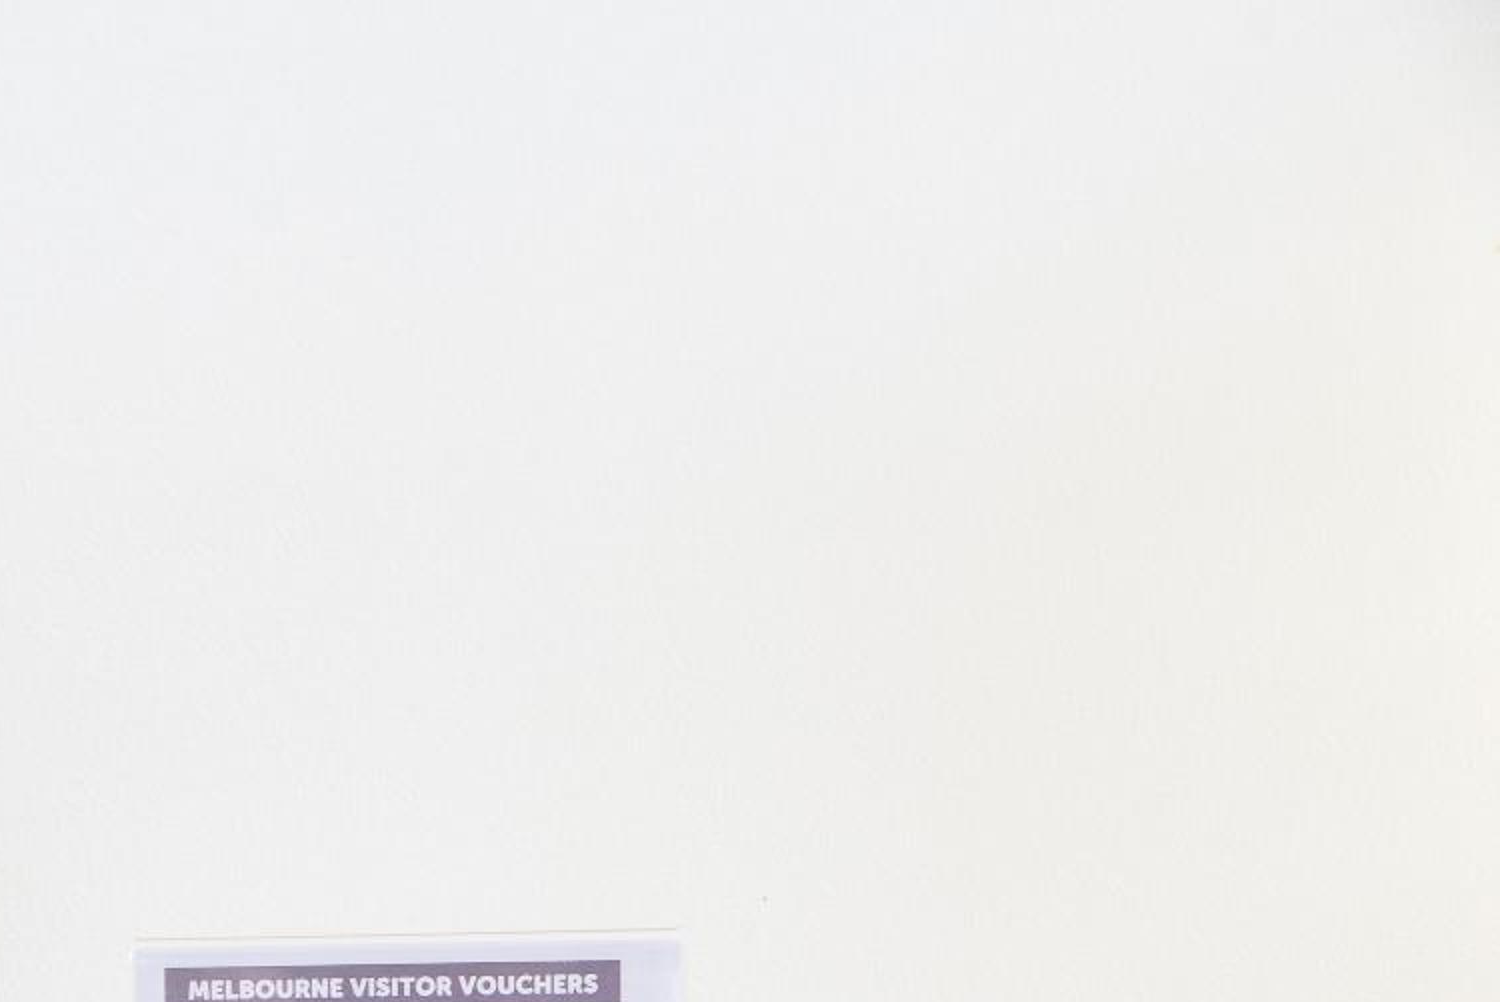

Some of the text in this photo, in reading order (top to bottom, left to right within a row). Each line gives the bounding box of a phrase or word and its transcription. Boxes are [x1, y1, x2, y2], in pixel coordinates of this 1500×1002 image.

[188, 973, 599, 1001] MELBOURNE VISITOR VOUCHERS
